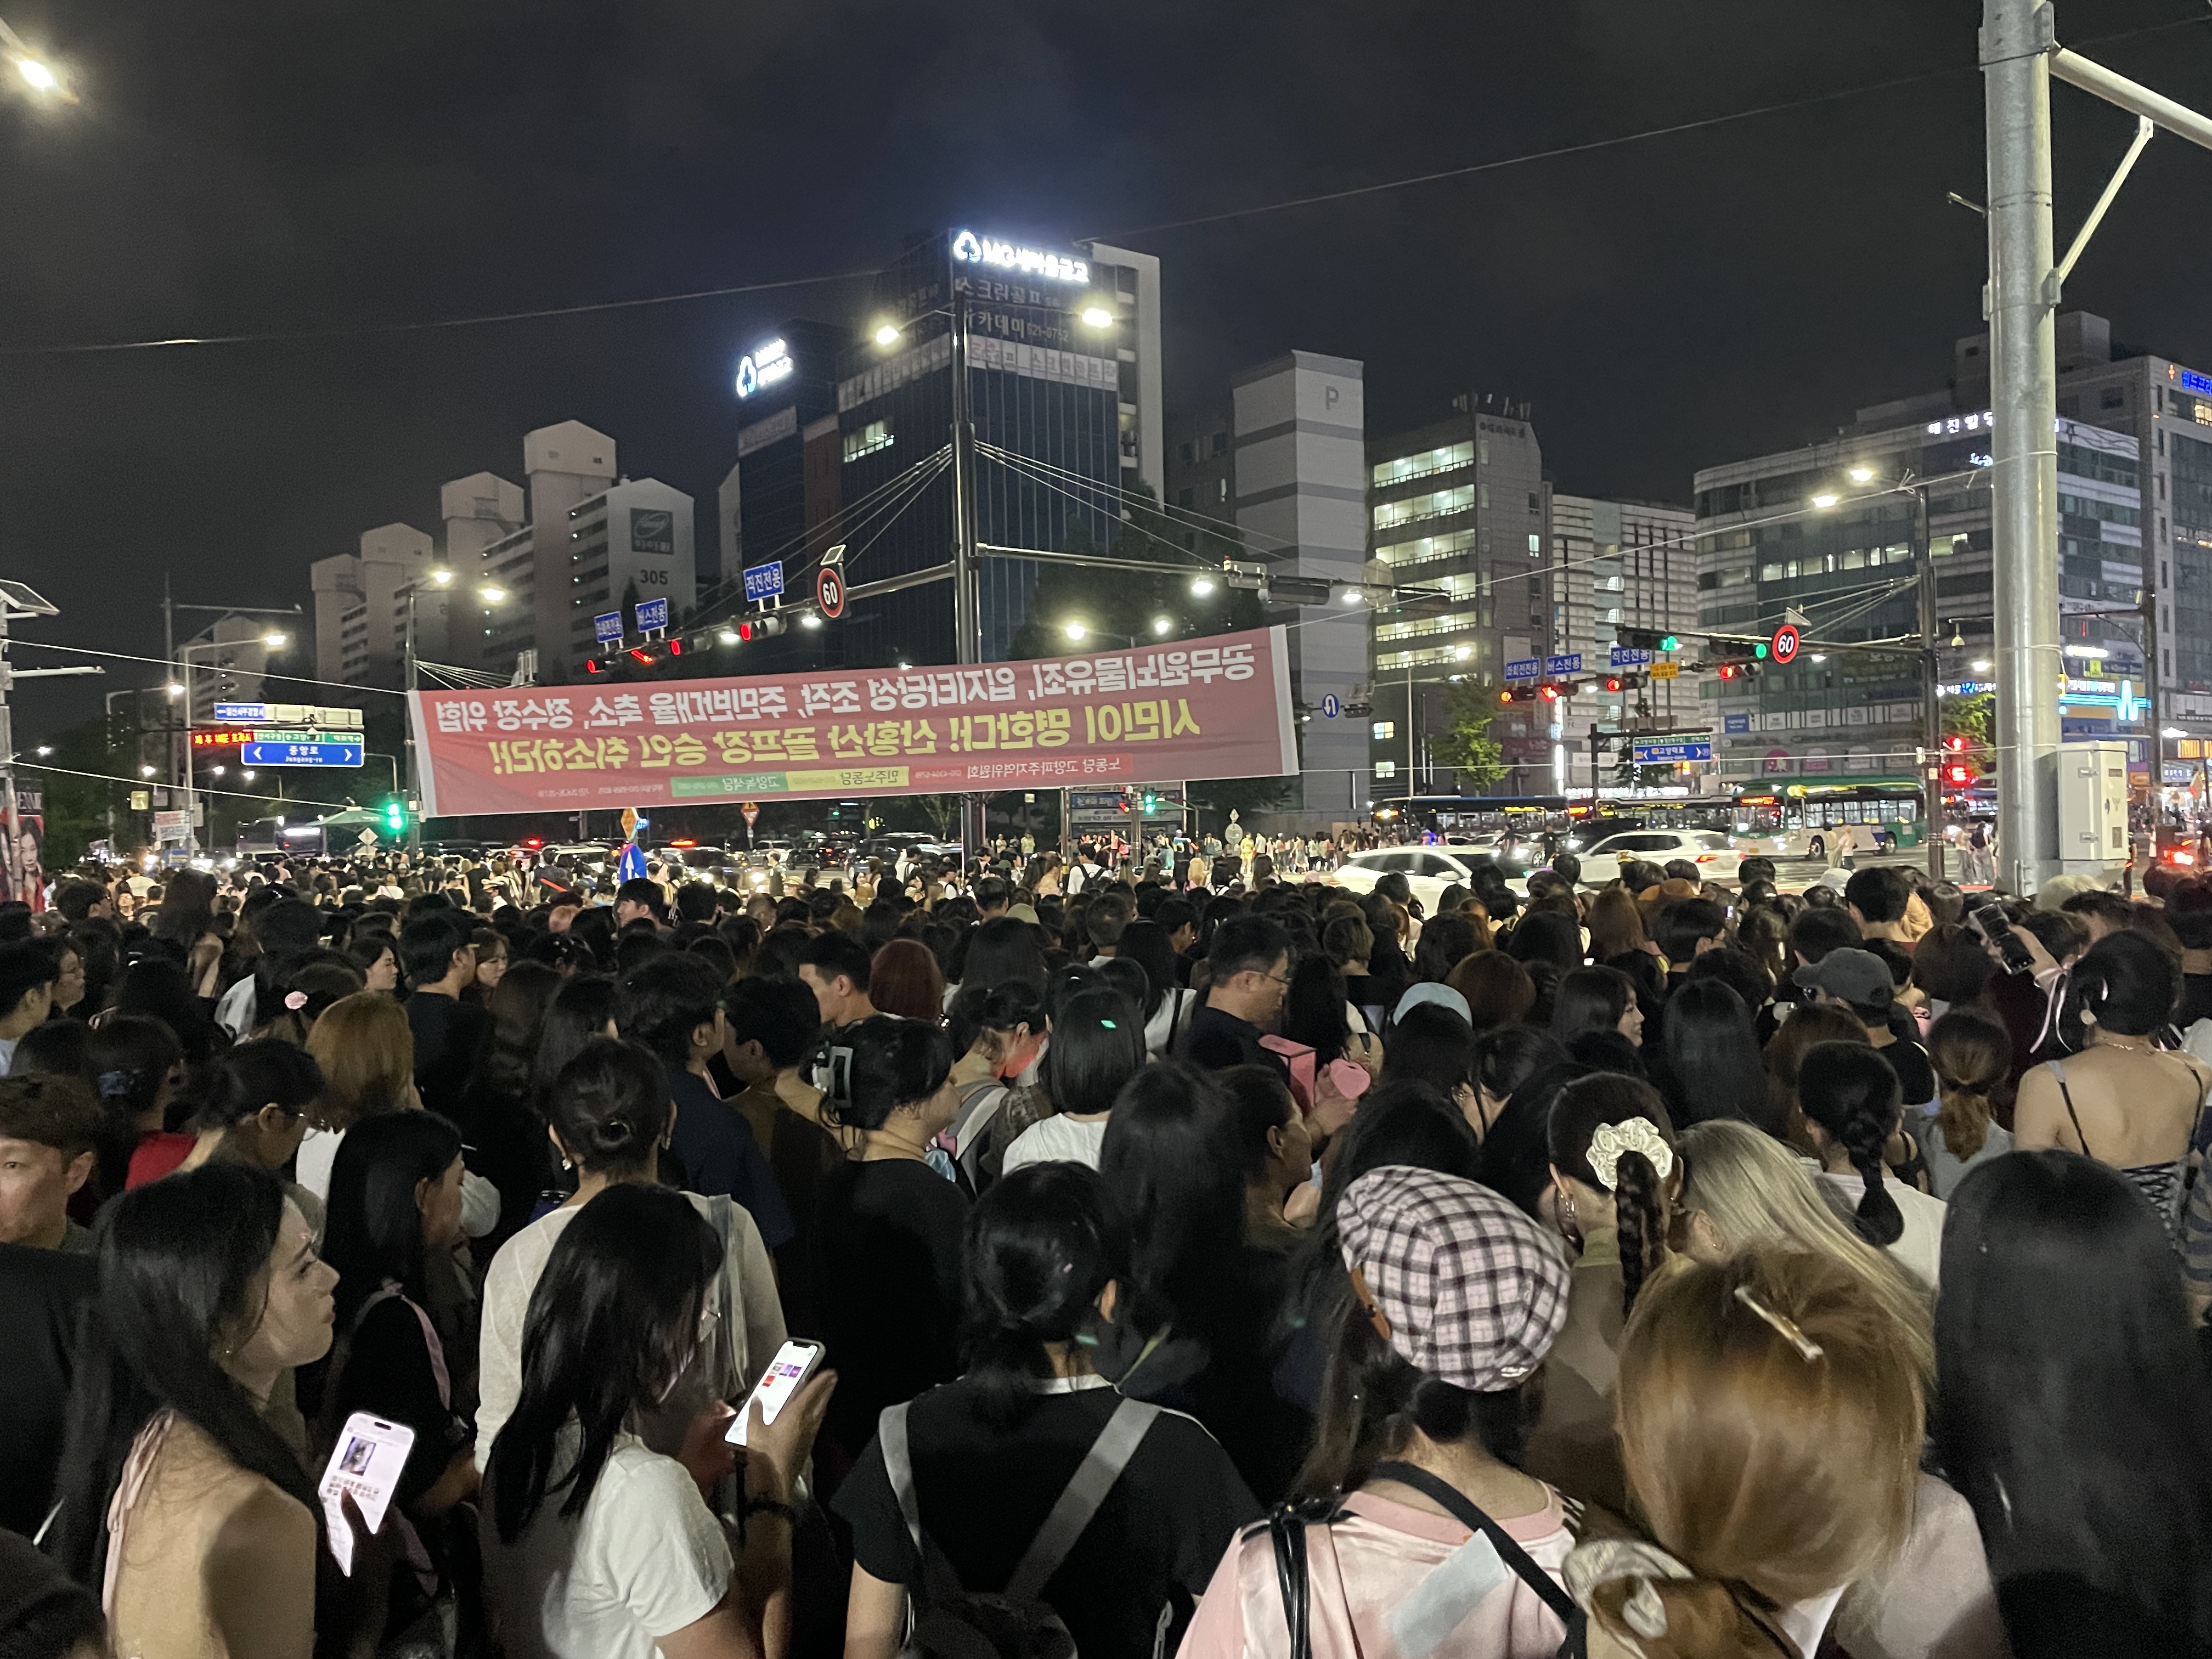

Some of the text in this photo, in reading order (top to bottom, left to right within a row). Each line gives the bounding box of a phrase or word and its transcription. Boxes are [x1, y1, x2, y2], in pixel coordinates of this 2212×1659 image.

[1325, 386, 1339, 410] P
[640, 569, 668, 585] 305
[747, 568, 780, 594] 직진전용
[823, 582, 838, 605] 60
[1778, 635, 1795, 653] 60
[1613, 648, 1649, 663] 직진전용
[1547, 657, 1580, 673] 버스전용
[289, 746, 319, 756] 중앙로
